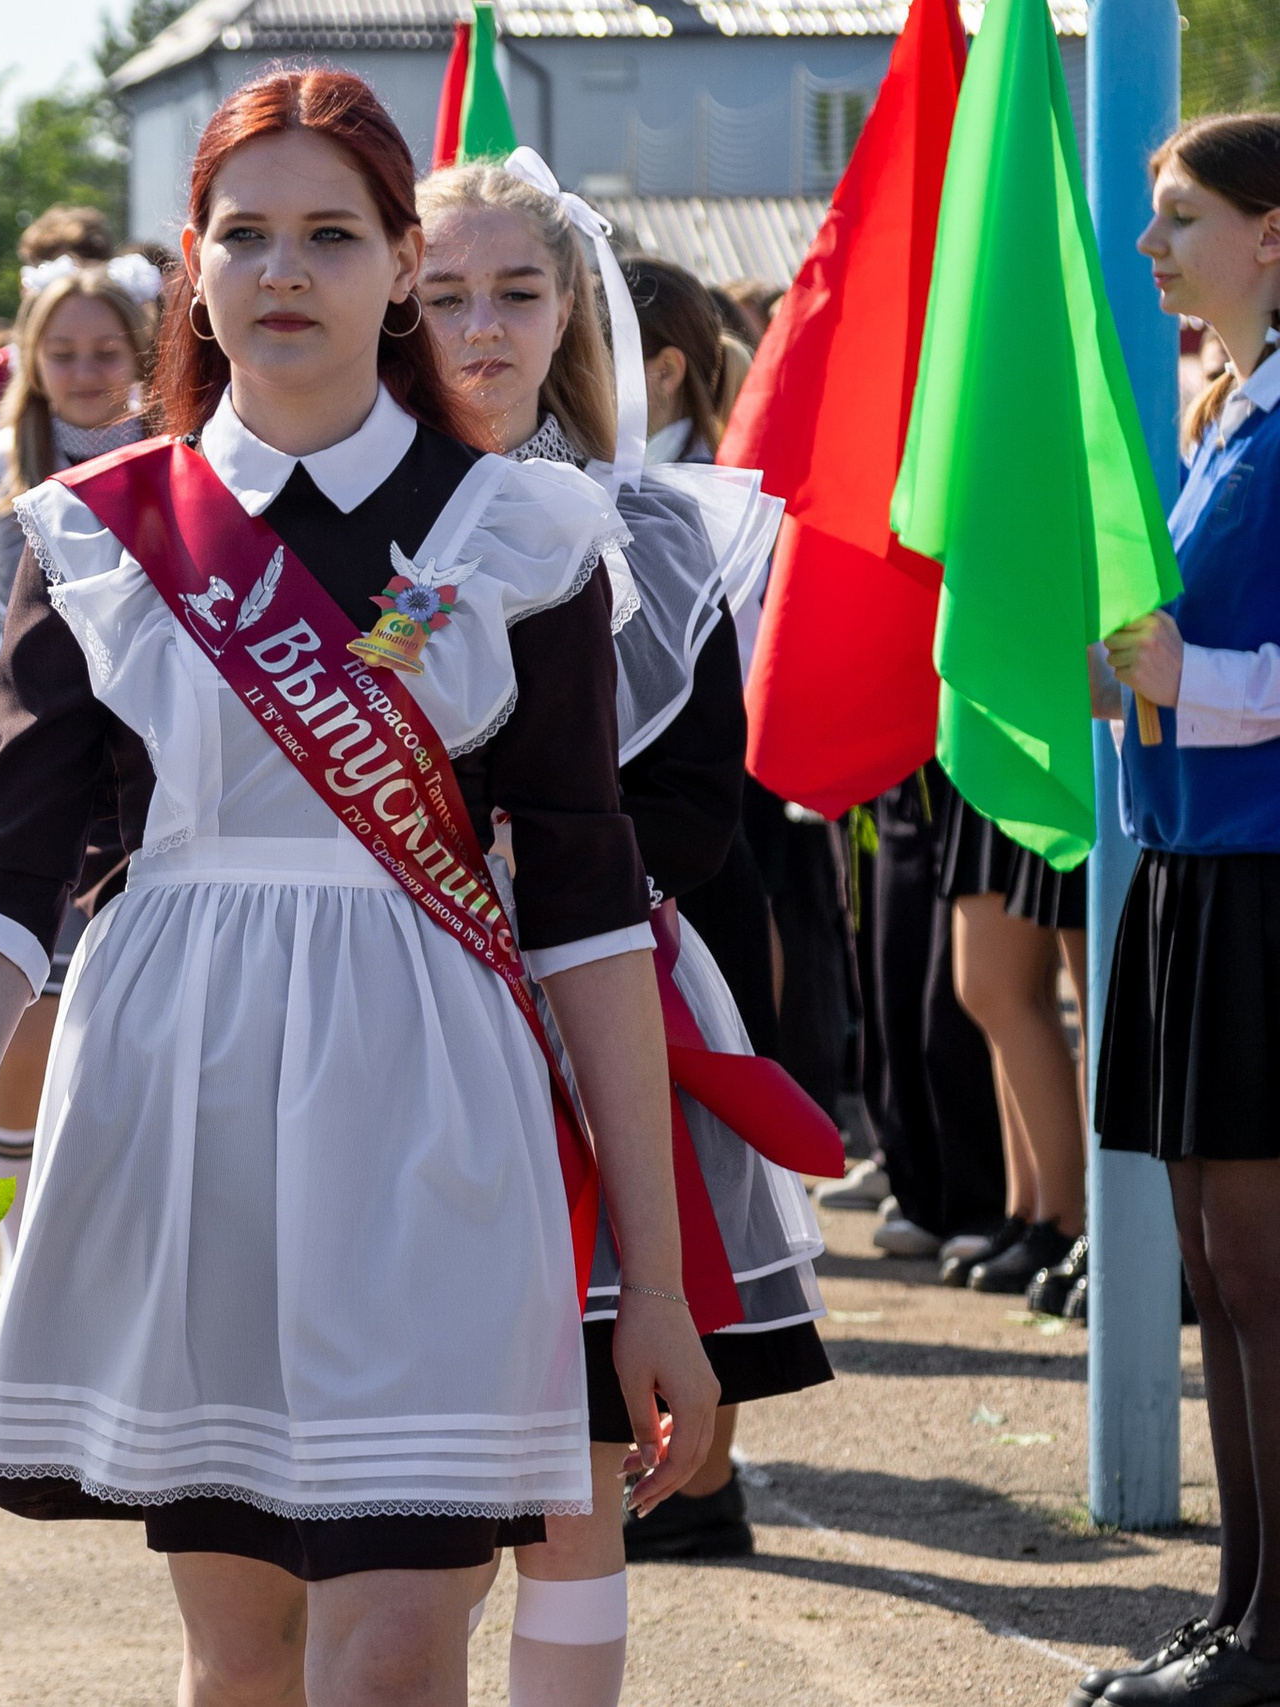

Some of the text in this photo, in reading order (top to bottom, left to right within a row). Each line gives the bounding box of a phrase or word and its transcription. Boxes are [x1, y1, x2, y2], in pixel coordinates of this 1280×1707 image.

[389, 620, 415, 637] 60
[244, 686, 309, 762] 11 "Б" класс
[342, 657, 433, 774] Некрасова
[341, 805, 371, 836] ГУО
[372, 833, 424, 896] "Средняя
[421, 892, 463, 932] школа
